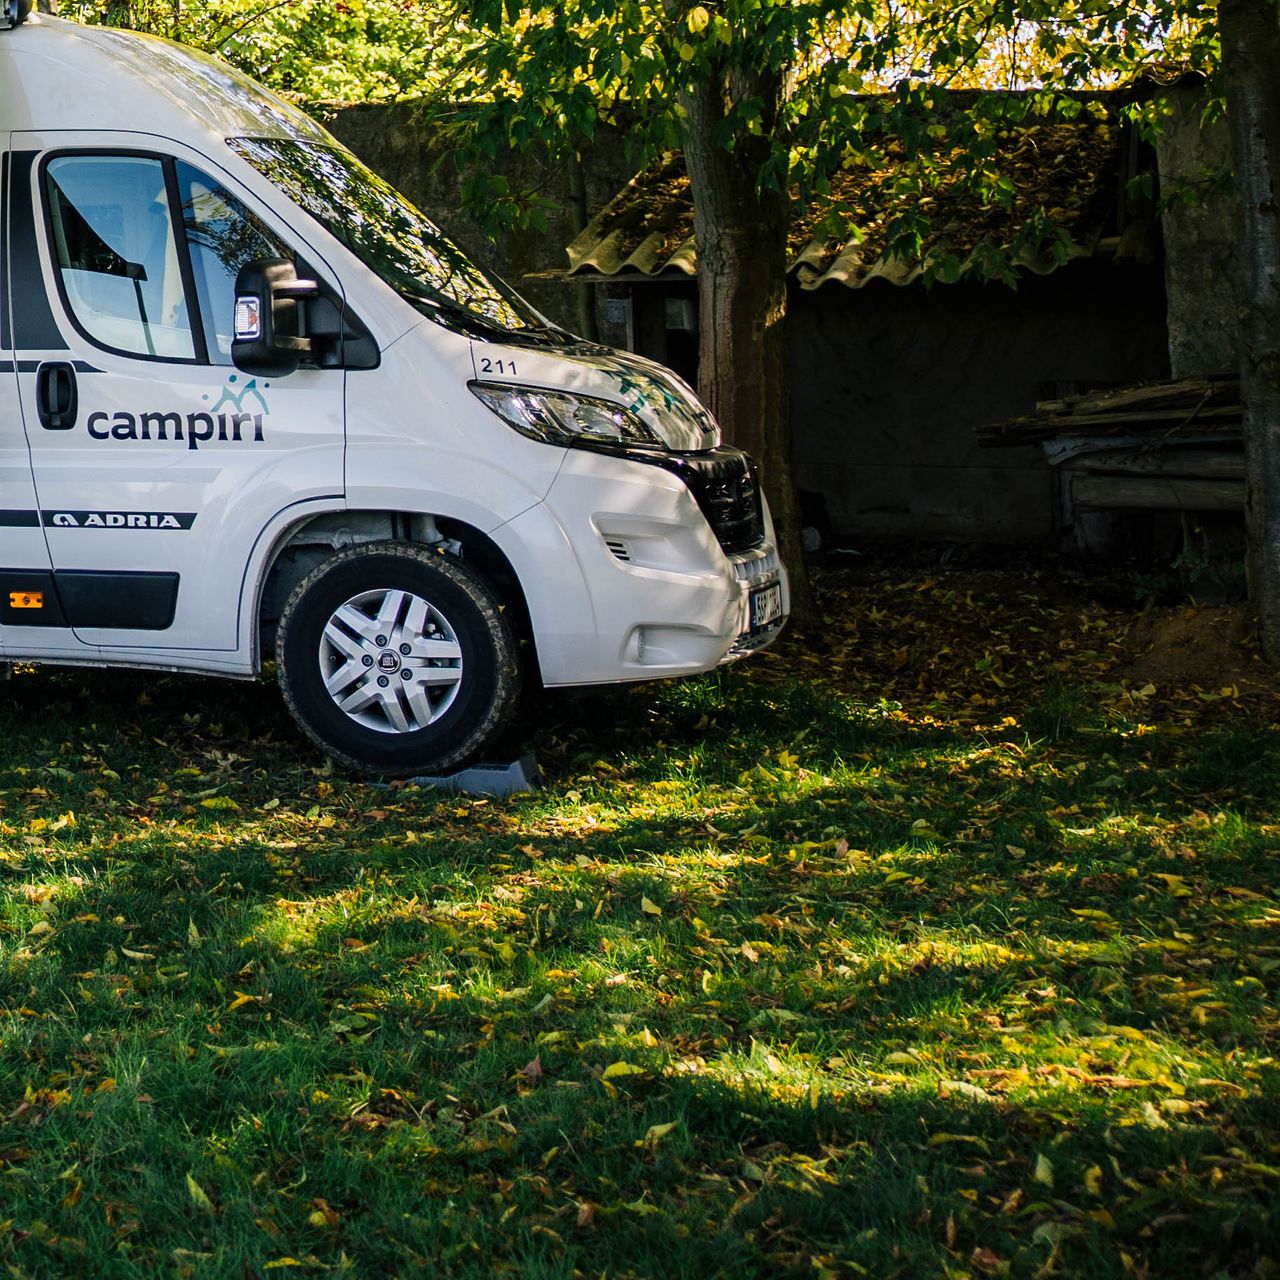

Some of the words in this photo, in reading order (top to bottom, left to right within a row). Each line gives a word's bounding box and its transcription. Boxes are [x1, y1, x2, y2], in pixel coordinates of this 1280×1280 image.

[481, 358, 516, 375] 211
[87, 411, 264, 450] campiri
[84, 513, 181, 528] ADRIA
